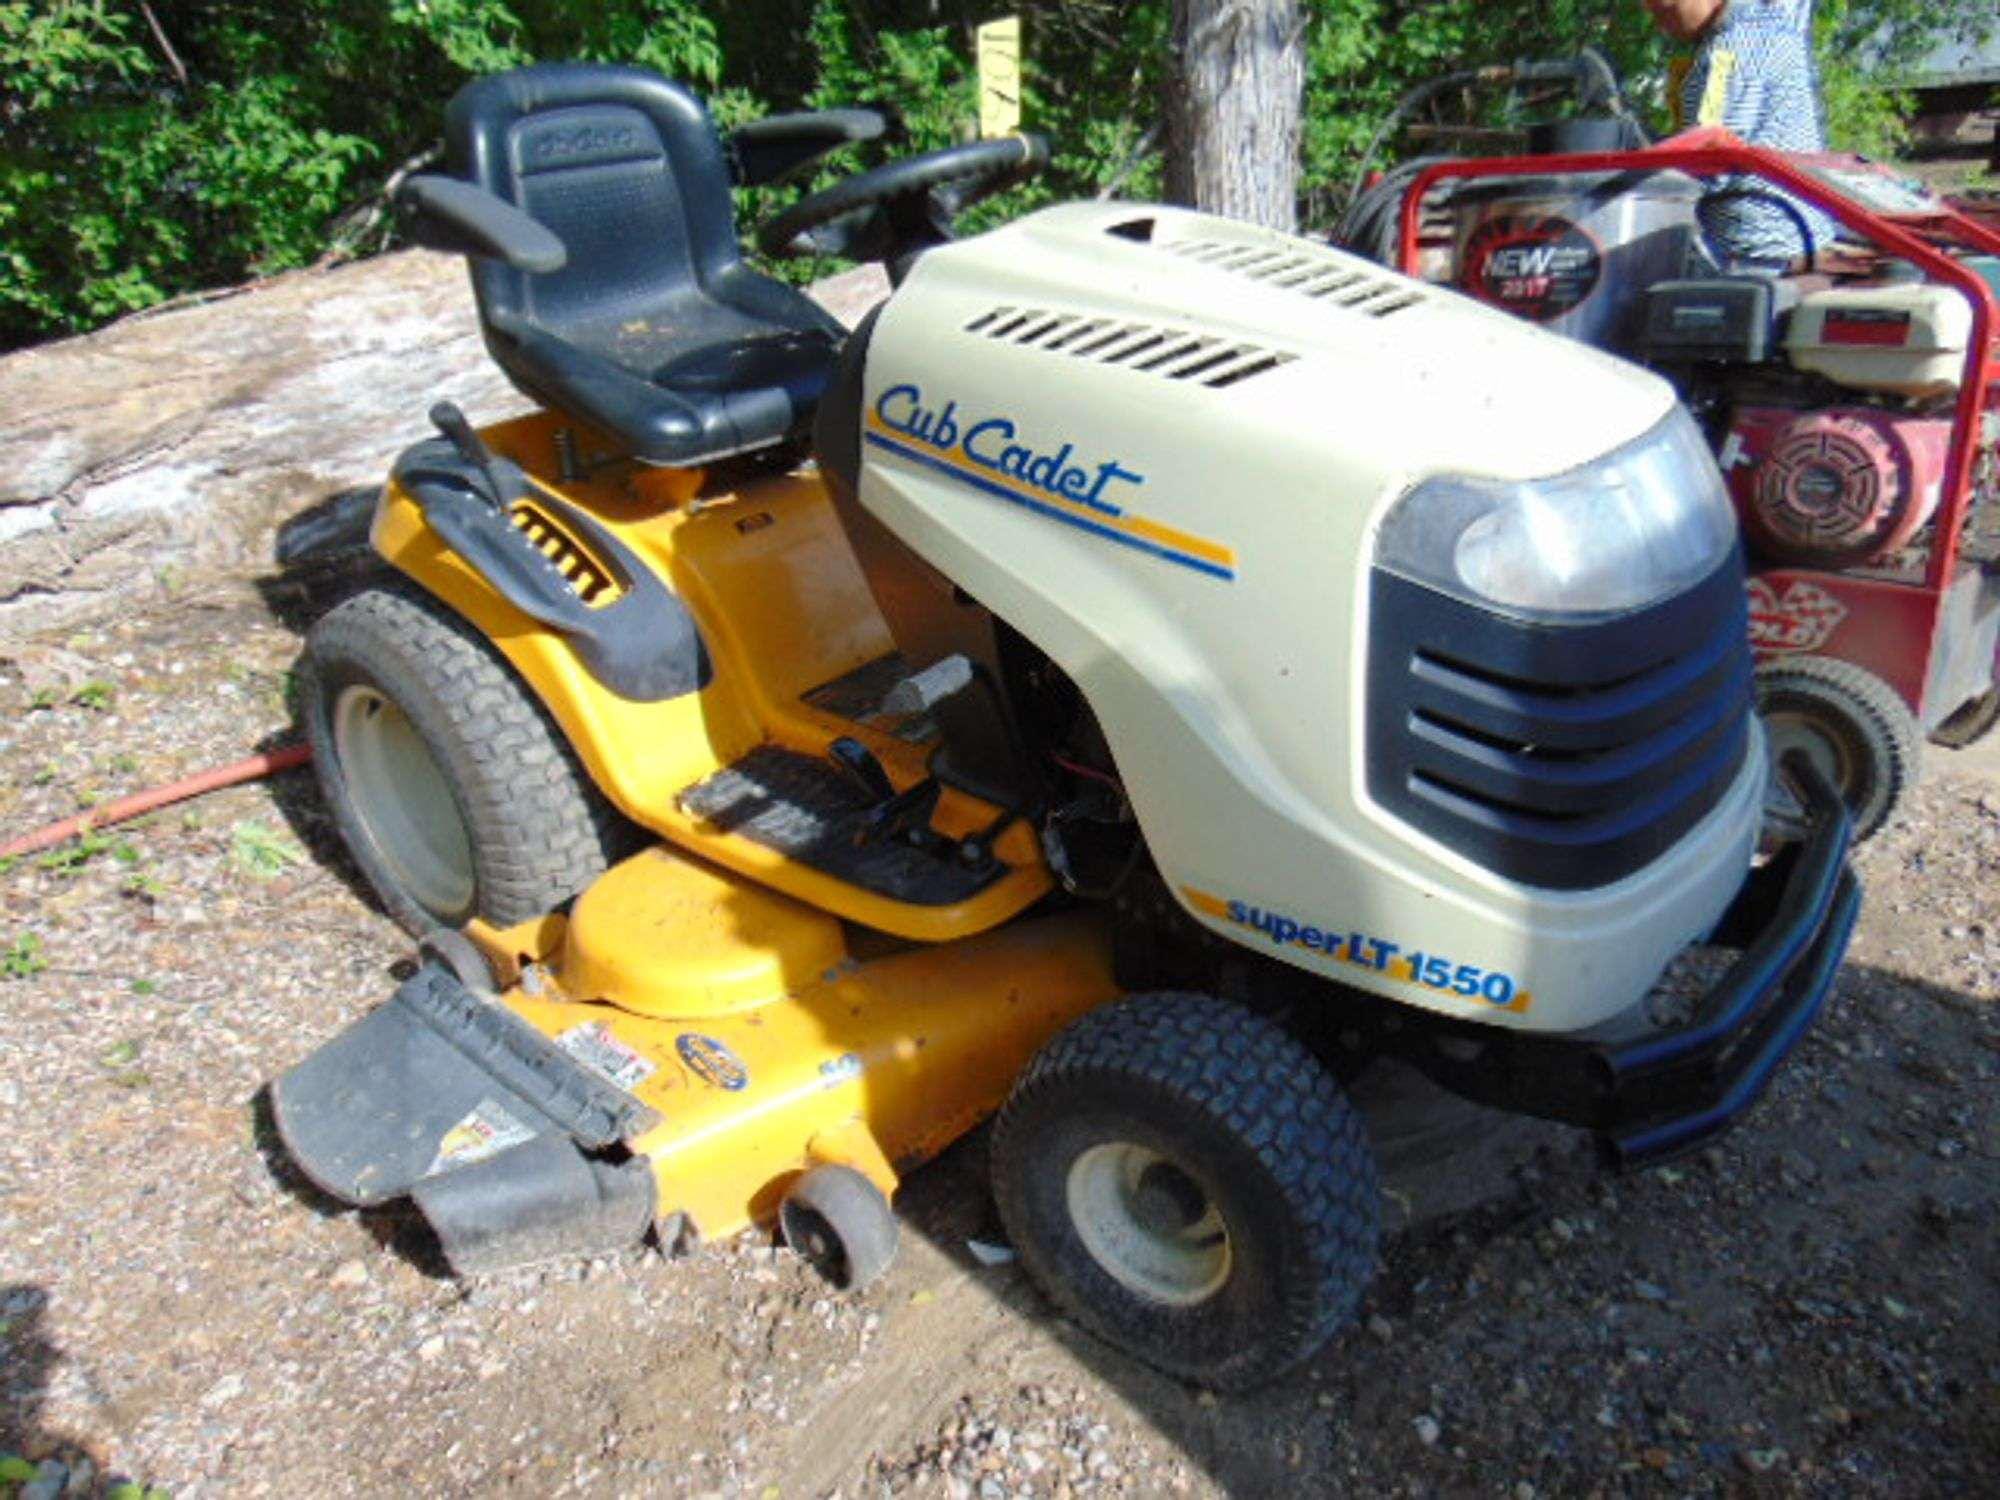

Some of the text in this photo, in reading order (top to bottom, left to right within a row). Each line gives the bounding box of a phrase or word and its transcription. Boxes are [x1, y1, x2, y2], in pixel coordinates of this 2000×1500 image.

[875, 384, 1144, 516] Cub Cadet
[1406, 952, 1516, 1004] 1550
